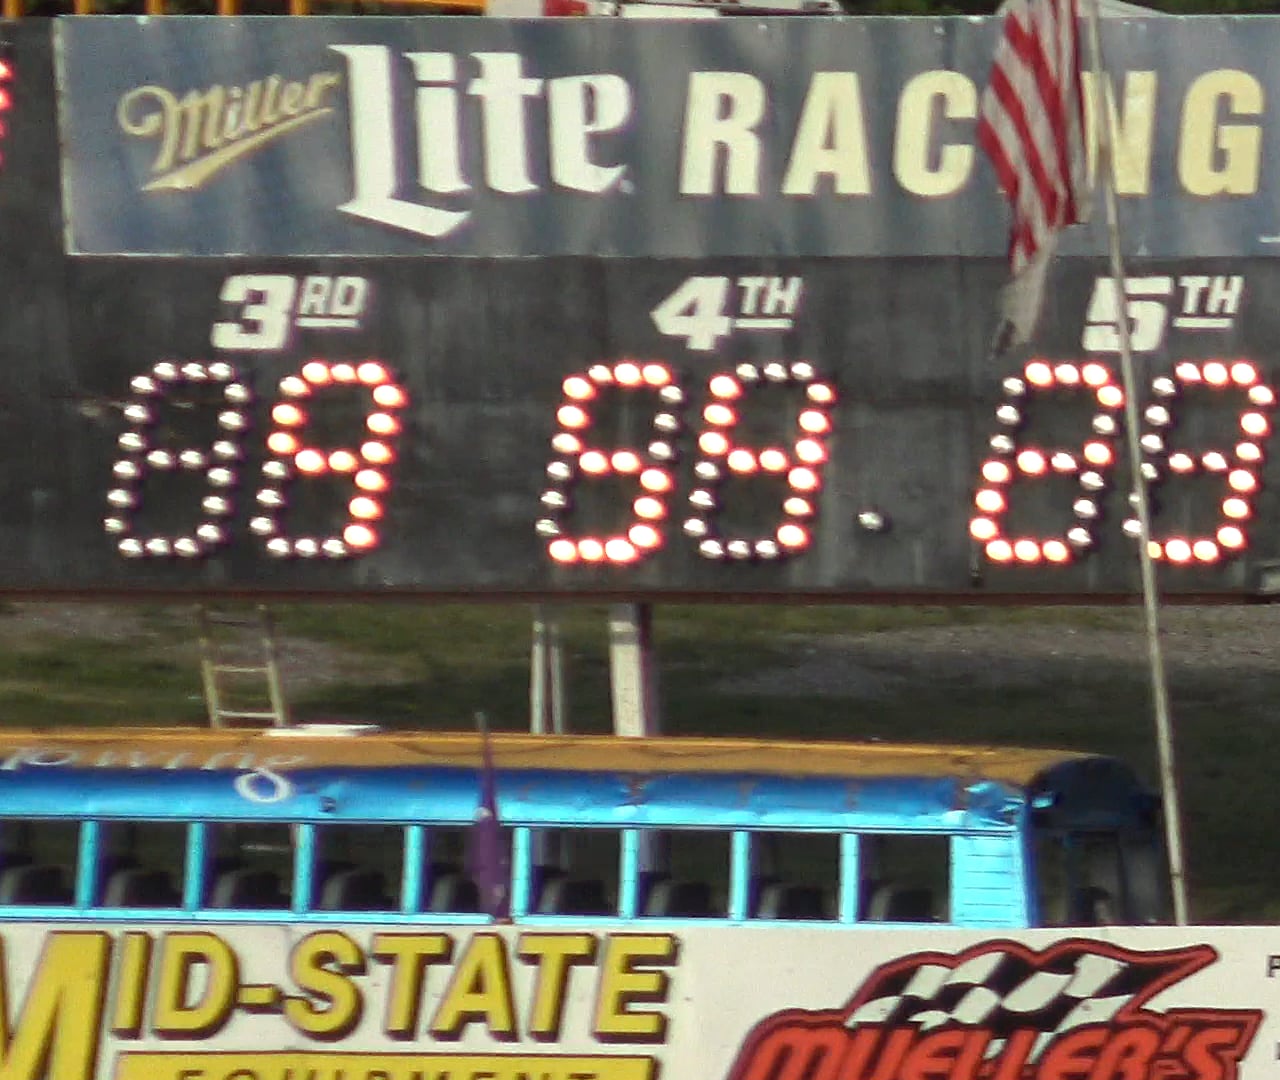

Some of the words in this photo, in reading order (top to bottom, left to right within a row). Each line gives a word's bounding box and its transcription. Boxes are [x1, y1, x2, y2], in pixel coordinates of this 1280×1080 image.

[117, 71, 341, 182] Miller
[328, 44, 632, 238] Lite
[679, 70, 1265, 196] RACNG
[210, 273, 371, 351] 3RD
[651, 275, 803, 351] 4TH
[1081, 275, 1244, 352] 5TH
